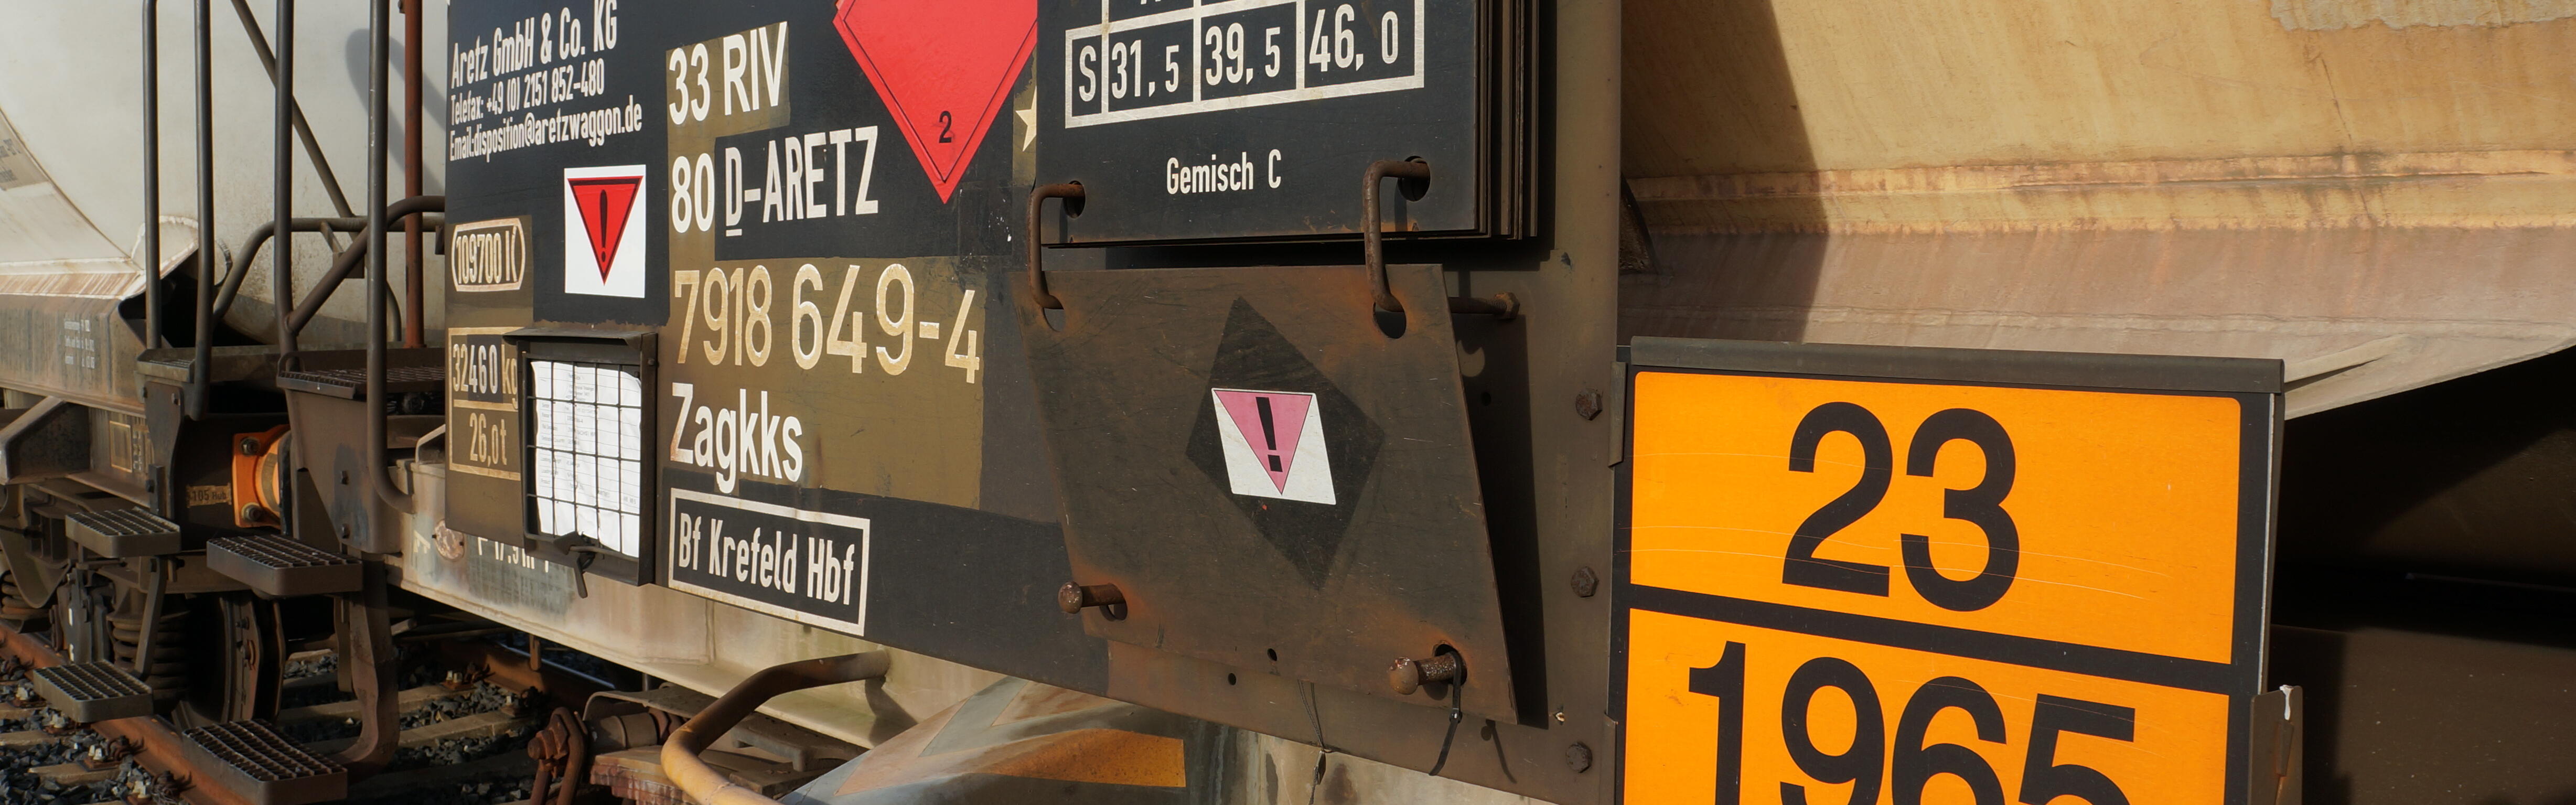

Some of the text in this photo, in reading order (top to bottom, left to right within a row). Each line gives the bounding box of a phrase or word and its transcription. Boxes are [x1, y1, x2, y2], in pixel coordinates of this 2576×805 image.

[451, 0, 617, 89] Aretz GmbH & Co. KG
[669, 21, 787, 125] 33 RIV
[1079, 45, 1096, 101] S
[451, 58, 604, 125] Telefax: +49 (0) 2151 852-480
[939, 111, 952, 143] 2
[672, 125, 878, 236] 80 D-ARETZ
[1166, 148, 1282, 195] Gemisch C
[456, 233, 502, 284] 109700
[675, 263, 980, 383] 7918 649-4
[453, 344, 518, 410] 32460 kg
[670, 382, 803, 493] Zagkks
[1782, 401, 2020, 612] 23
[679, 512, 855, 605] Bf Krefeld Hbf
[1688, 641, 2135, 805] 1965
